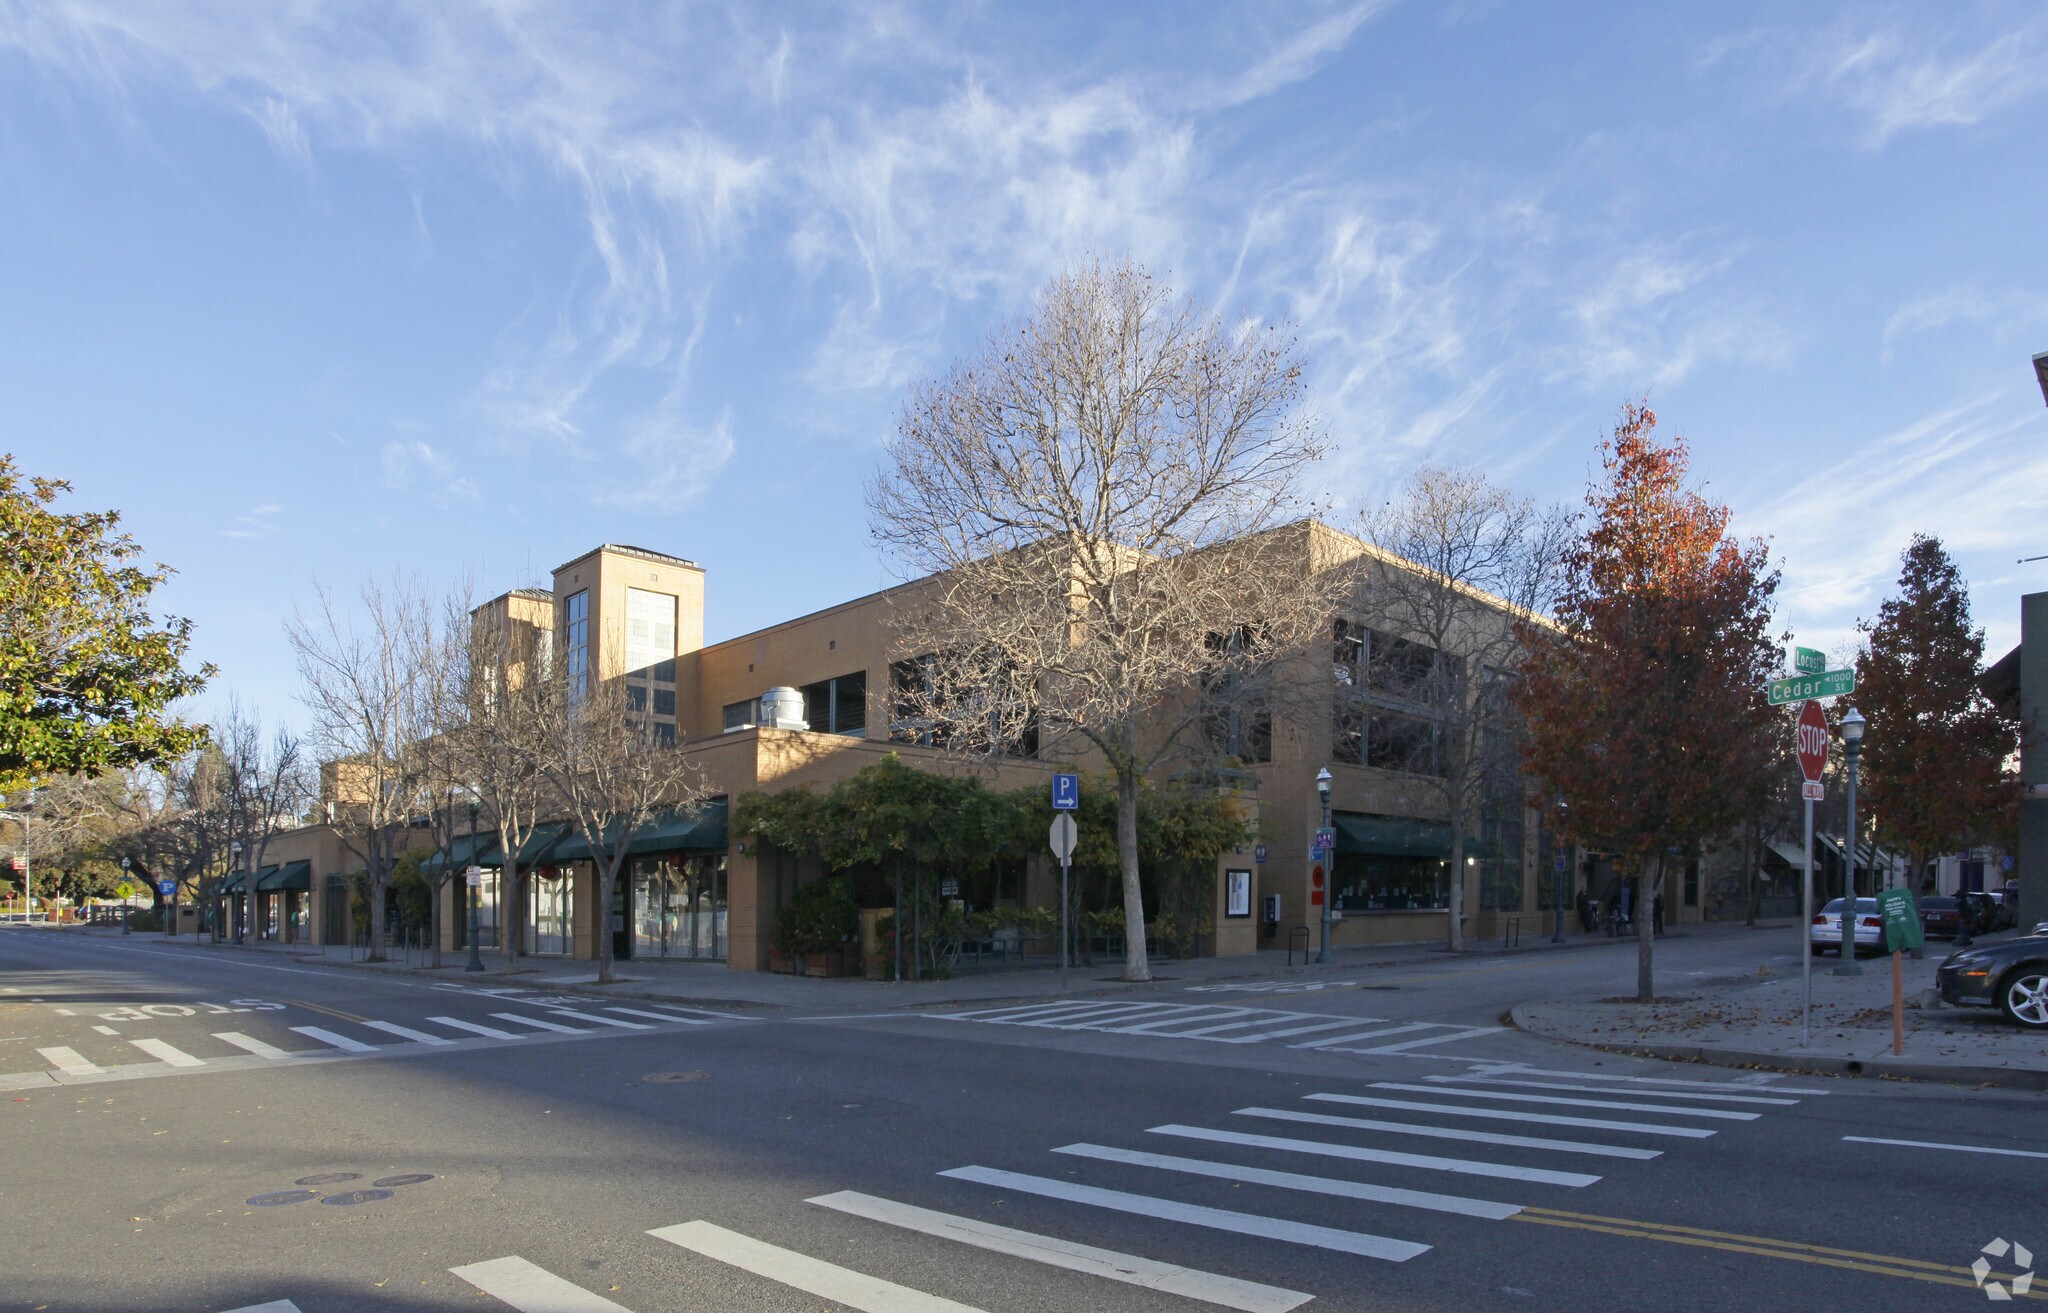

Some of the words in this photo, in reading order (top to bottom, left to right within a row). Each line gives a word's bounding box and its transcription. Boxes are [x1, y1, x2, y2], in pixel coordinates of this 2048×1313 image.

[1773, 681, 1821, 700] Cedar
[1831, 672, 1851, 683] 1000
[1835, 682, 1845, 692] St
[1800, 723, 1826, 757] STOP
[1061, 777, 1070, 796] P
[1804, 784, 1812, 797] ALL
[1813, 785, 1824, 798] WAY
[162, 882, 174, 893] P
[98, 999, 287, 1022] STOP
